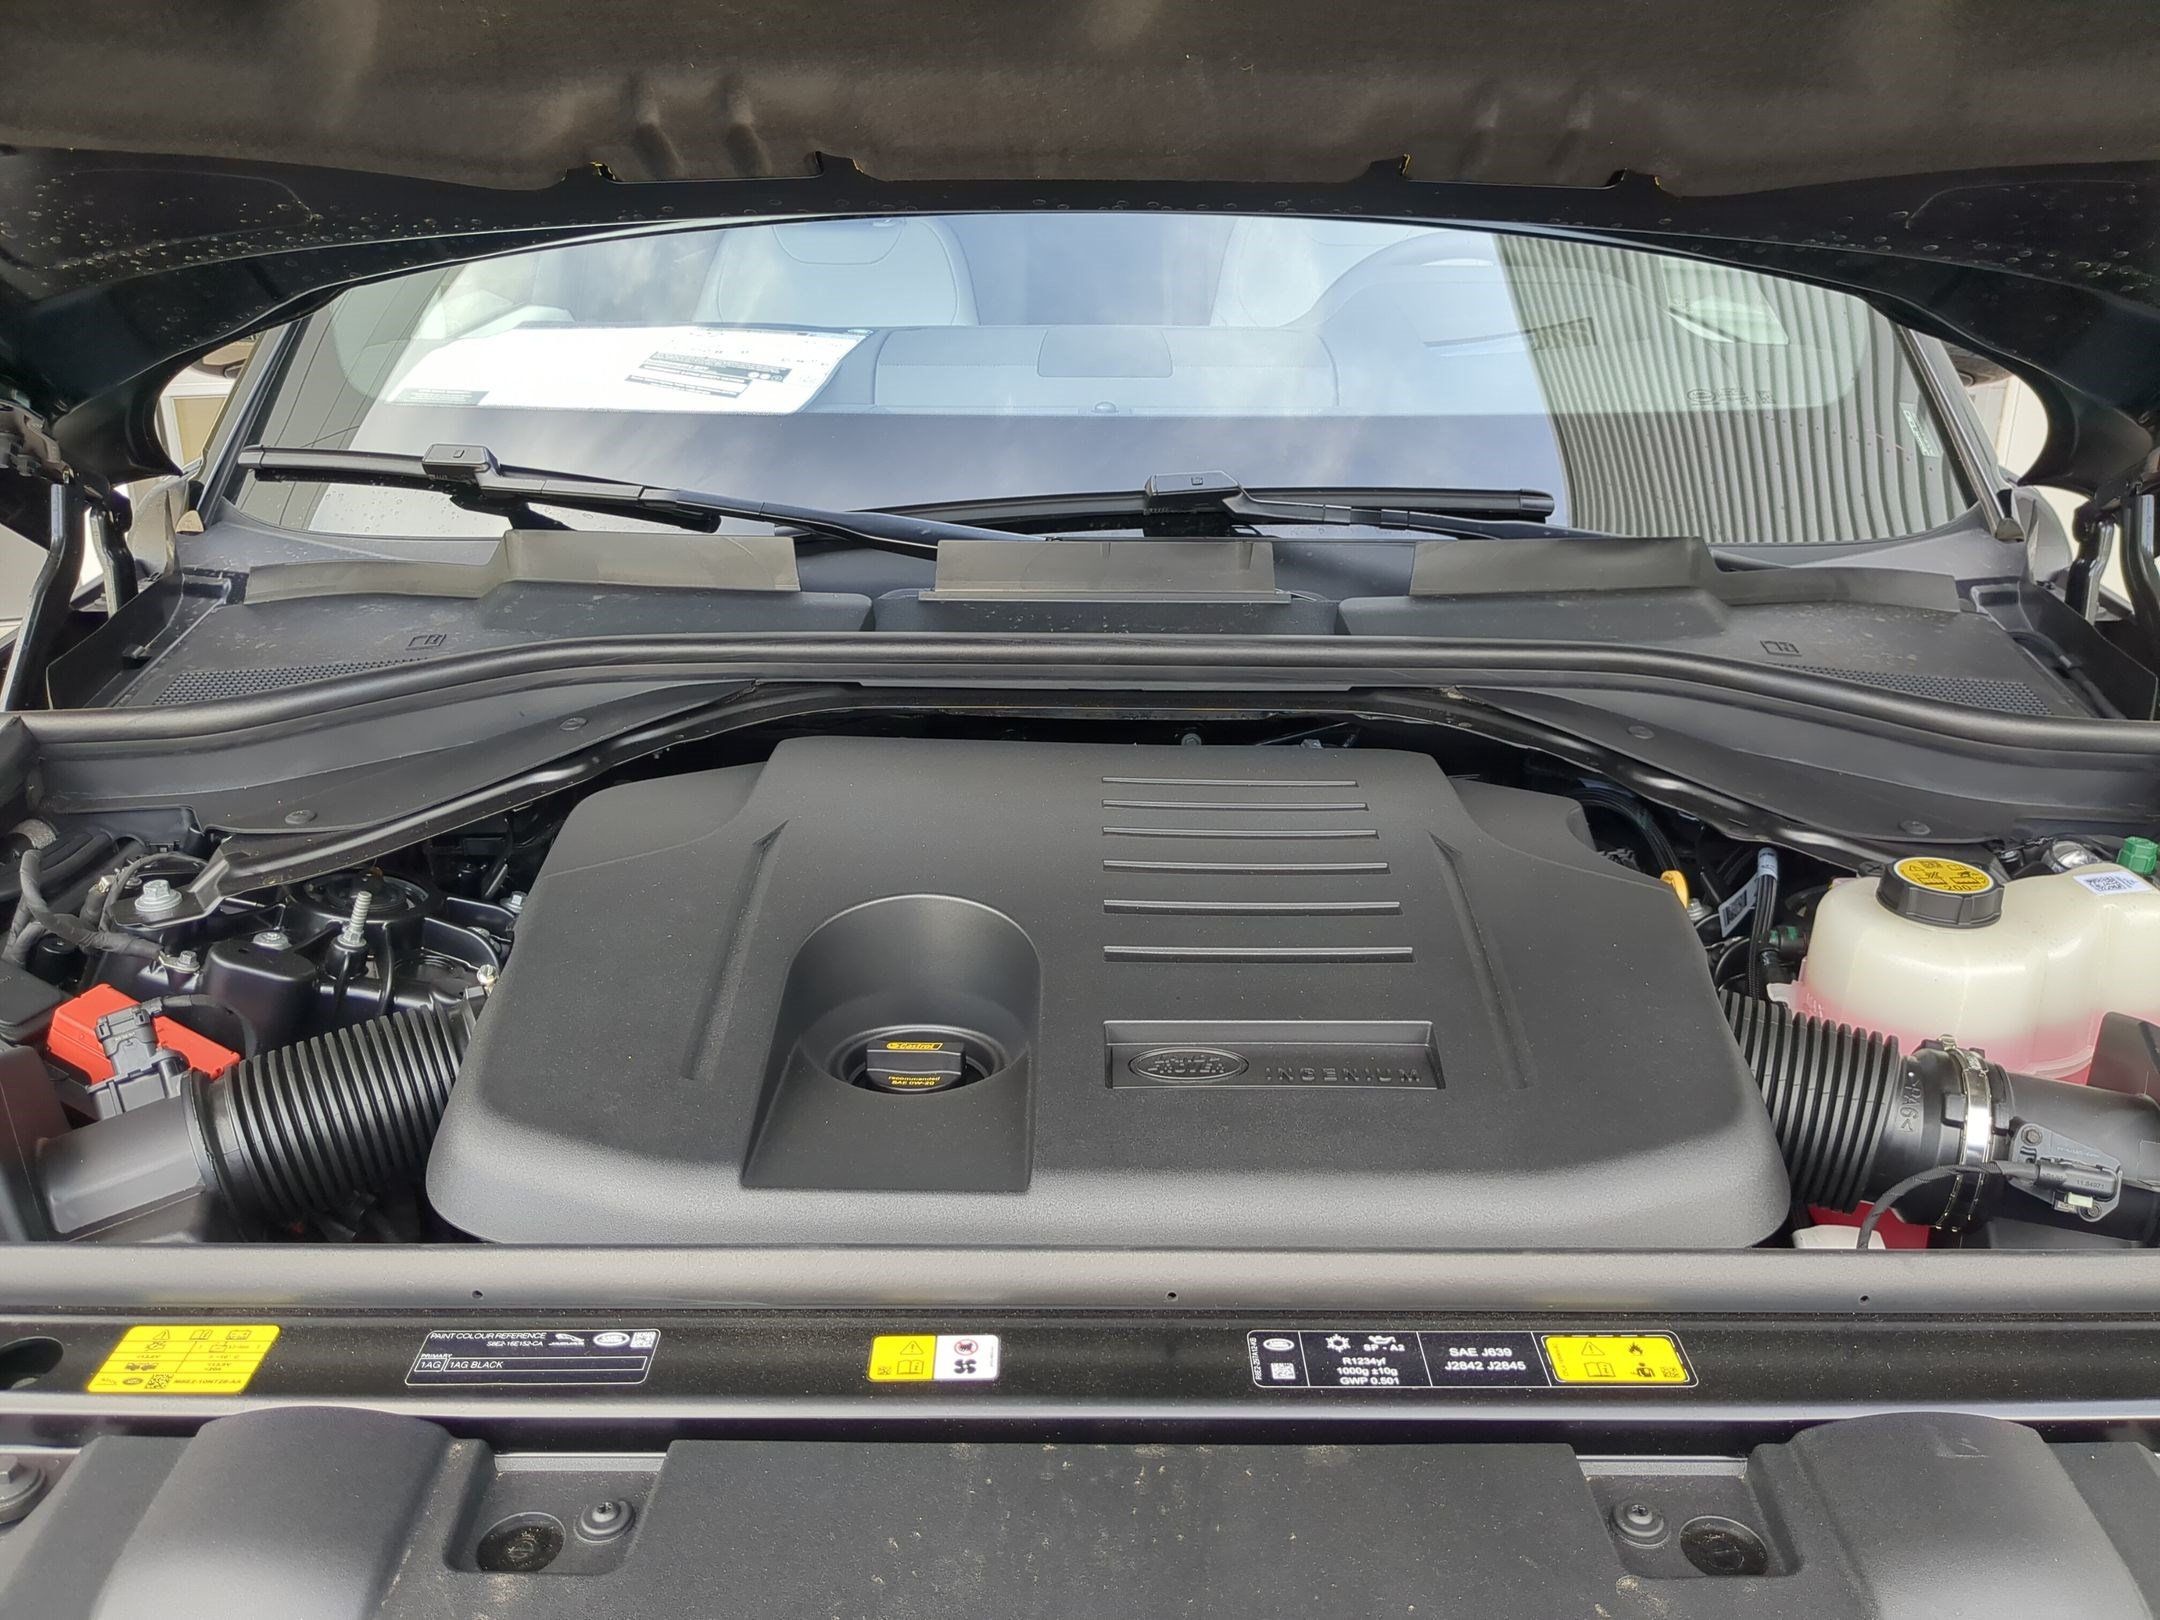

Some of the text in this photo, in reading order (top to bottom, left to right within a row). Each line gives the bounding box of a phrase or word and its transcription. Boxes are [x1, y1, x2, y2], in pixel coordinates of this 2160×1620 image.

[899, 1042, 933, 1050] Castrol
[1265, 1067, 1421, 1082] INGENIUM
[430, 1332, 547, 1340] PAINT COLOUR REFERENCE
[1389, 1343, 1405, 1352] A2
[1448, 1347, 1513, 1357] SAE J639
[421, 1360, 442, 1369] 1AG
[450, 1360, 504, 1369] 1AG BLACK
[1342, 1356, 1387, 1367] R1234yf
[1444, 1360, 1527, 1371] J2842 J2845
[1336, 1366, 1399, 1377] 1000g ±10g
[1339, 1376, 1400, 1385] GWP 0.501
